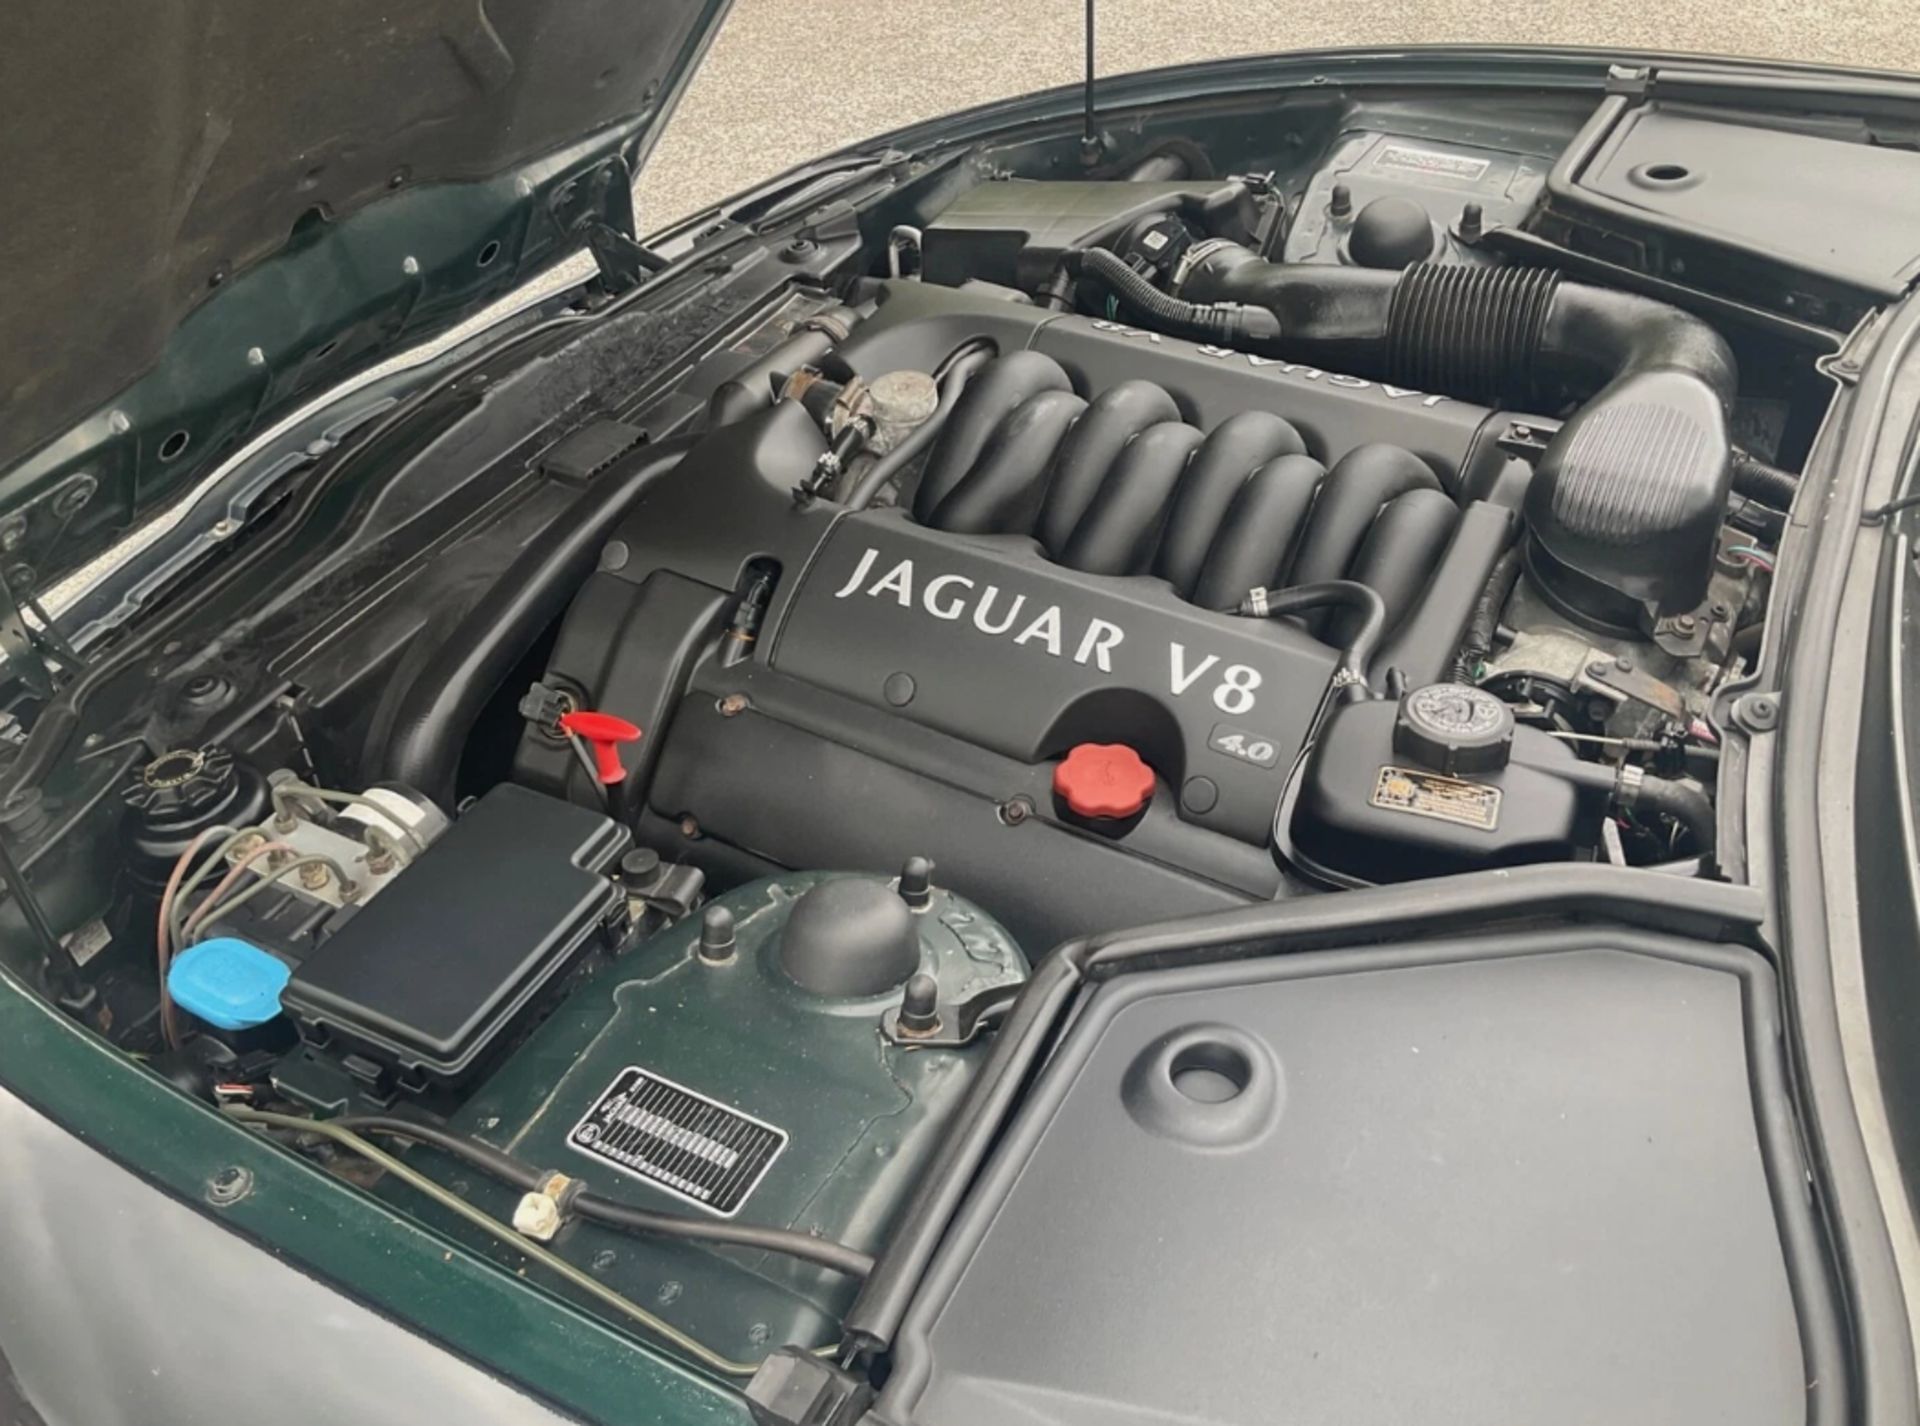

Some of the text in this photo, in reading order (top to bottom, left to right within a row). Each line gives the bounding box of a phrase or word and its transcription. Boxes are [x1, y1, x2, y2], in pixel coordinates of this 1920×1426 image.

[835, 549, 1261, 713] JAGUAR V8
[1217, 734, 1273, 760] 4.0
